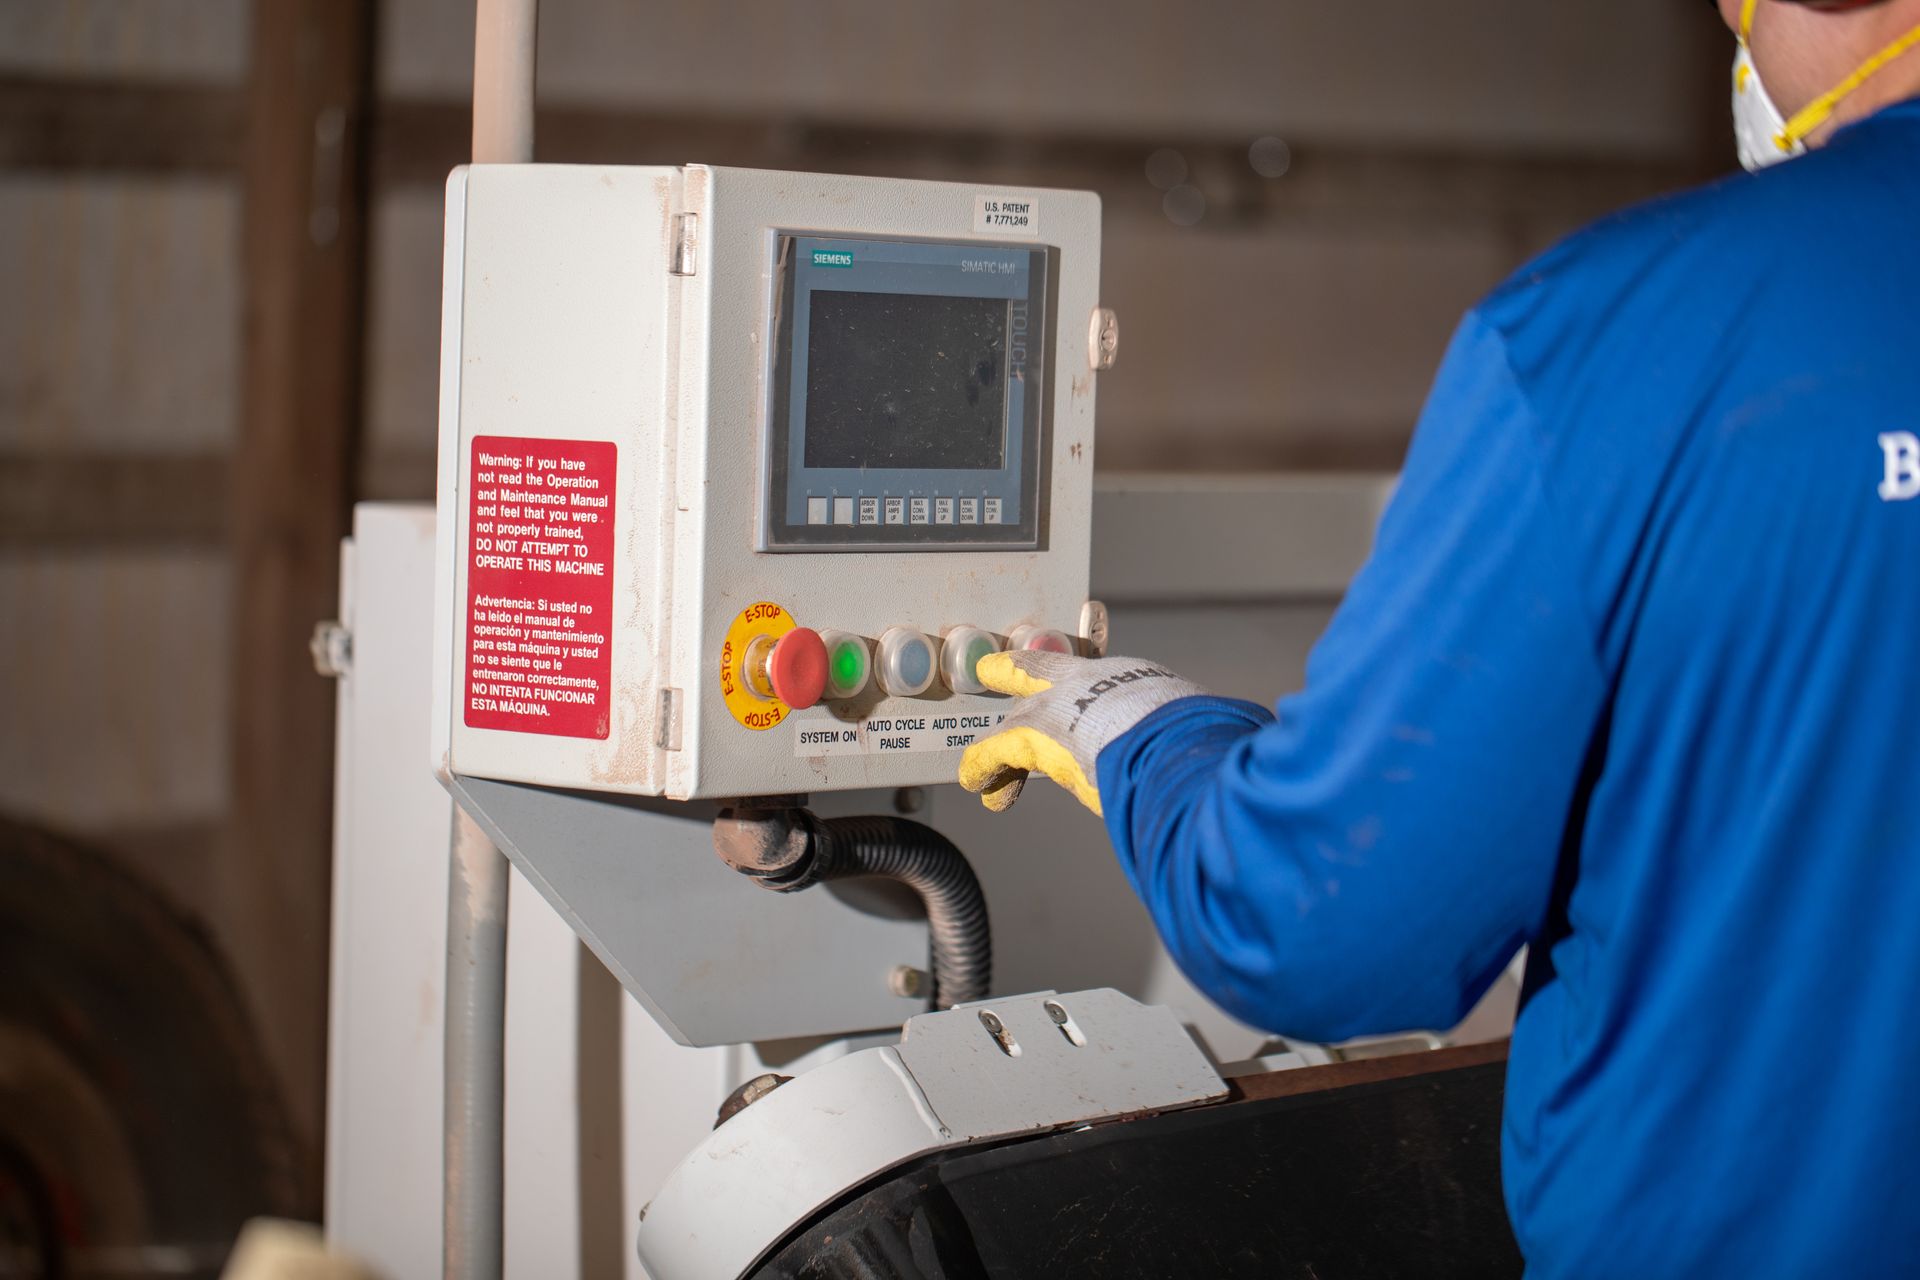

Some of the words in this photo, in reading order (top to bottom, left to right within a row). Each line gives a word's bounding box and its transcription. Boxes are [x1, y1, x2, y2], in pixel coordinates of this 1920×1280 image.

[984, 202, 999, 212] U.S.
[1002, 203, 1029, 213] PATENT
[986, 215, 991, 224] #
[994, 215, 1028, 226] 7,771,249
[814, 253, 851, 265] SIEMENS
[961, 260, 996, 273] SIMATIC
[998, 263, 1015, 274] HMI
[1011, 302, 1028, 377] TOUCH
[479, 453, 522, 470] Warning:
[526, 456, 533, 467] If
[538, 459, 557, 471] you
[561, 457, 586, 470] have
[1877, 430, 1920, 502] B
[478, 473, 494, 483] not
[499, 473, 522, 484] read
[526, 474, 543, 485] the
[547, 474, 599, 488] Operation
[478, 489, 496, 500] and
[501, 490, 566, 504] Maintenance
[570, 494, 608, 507] Manual
[477, 505, 496, 516] and
[500, 505, 519, 518] feel
[524, 507, 545, 519] that
[549, 511, 568, 522] you
[572, 513, 598, 522] were
[477, 522, 493, 533] not
[497, 524, 540, 537] properly
[545, 526, 584, 540] trained,
[476, 538, 492, 551] DO
[496, 540, 517, 552] NOT
[521, 542, 569, 556] ATTEMPT
[574, 545, 588, 557] TO
[476, 555, 523, 569] OPERATE
[527, 558, 551, 572] THIS
[556, 561, 604, 575] MACHINE
[475, 594, 535, 610] Advertencia:
[538, 599, 548, 610] Si
[550, 602, 577, 613] usted
[580, 604, 592, 614] no
[474, 609, 486, 621] ha
[514, 612, 522, 623] el
[525, 613, 560, 626] manual
[563, 616, 575, 628] de
[745, 604, 781, 623] E-STOP
[474, 624, 522, 637] operación
[524, 630, 530, 640] y
[532, 628, 604, 644] mantenimiento
[473, 640, 494, 651] para
[496, 641, 516, 652] esta
[519, 642, 560, 656] máquina
[563, 648, 569, 659] y
[571, 647, 598, 658] usted
[473, 655, 485, 664] no
[488, 656, 499, 665] se
[502, 655, 530, 667] siente
[533, 659, 551, 671] que
[553, 659, 562, 670] le
[722, 641, 734, 696] E-STOP
[472, 668, 525, 682] entrenaron
[527, 673, 599, 691] correctamente,
[472, 683, 487, 695] NO
[489, 685, 534, 699] INTENTA
[534, 688, 595, 704] FUNCIONAR
[471, 698, 497, 711] ESTA
[500, 701, 550, 716] MÁQUINA.
[745, 708, 781, 727] E-STOP
[866, 719, 892, 731] AUTO
[896, 719, 925, 731] CYCLE
[933, 717, 958, 730] AUTO
[961, 716, 990, 728] CYCLE
[800, 731, 839, 744] SYSTEM
[843, 731, 857, 742] ON
[880, 738, 911, 749] PAUSE
[946, 734, 975, 747] START
